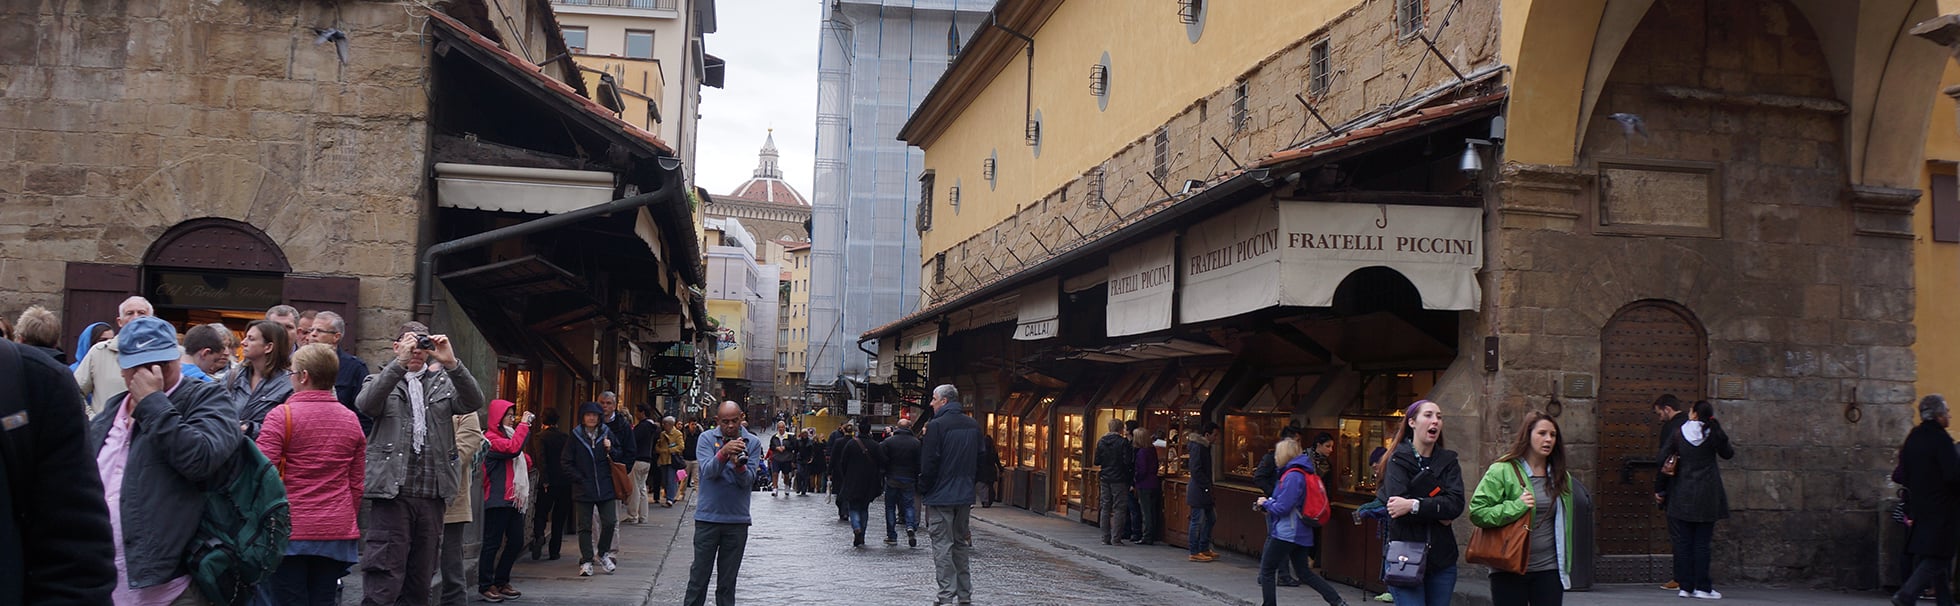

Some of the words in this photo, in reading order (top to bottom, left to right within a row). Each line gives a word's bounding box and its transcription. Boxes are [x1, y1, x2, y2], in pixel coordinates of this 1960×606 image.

[1190, 245, 1233, 276] FRATELLI
[1236, 228, 1279, 263] PICCINI
[1287, 232, 1385, 251] FRATELLI
[1396, 236, 1475, 255] PICCINI
[1110, 274, 1138, 297] FRATELLI
[1140, 264, 1171, 290] PICCINI
